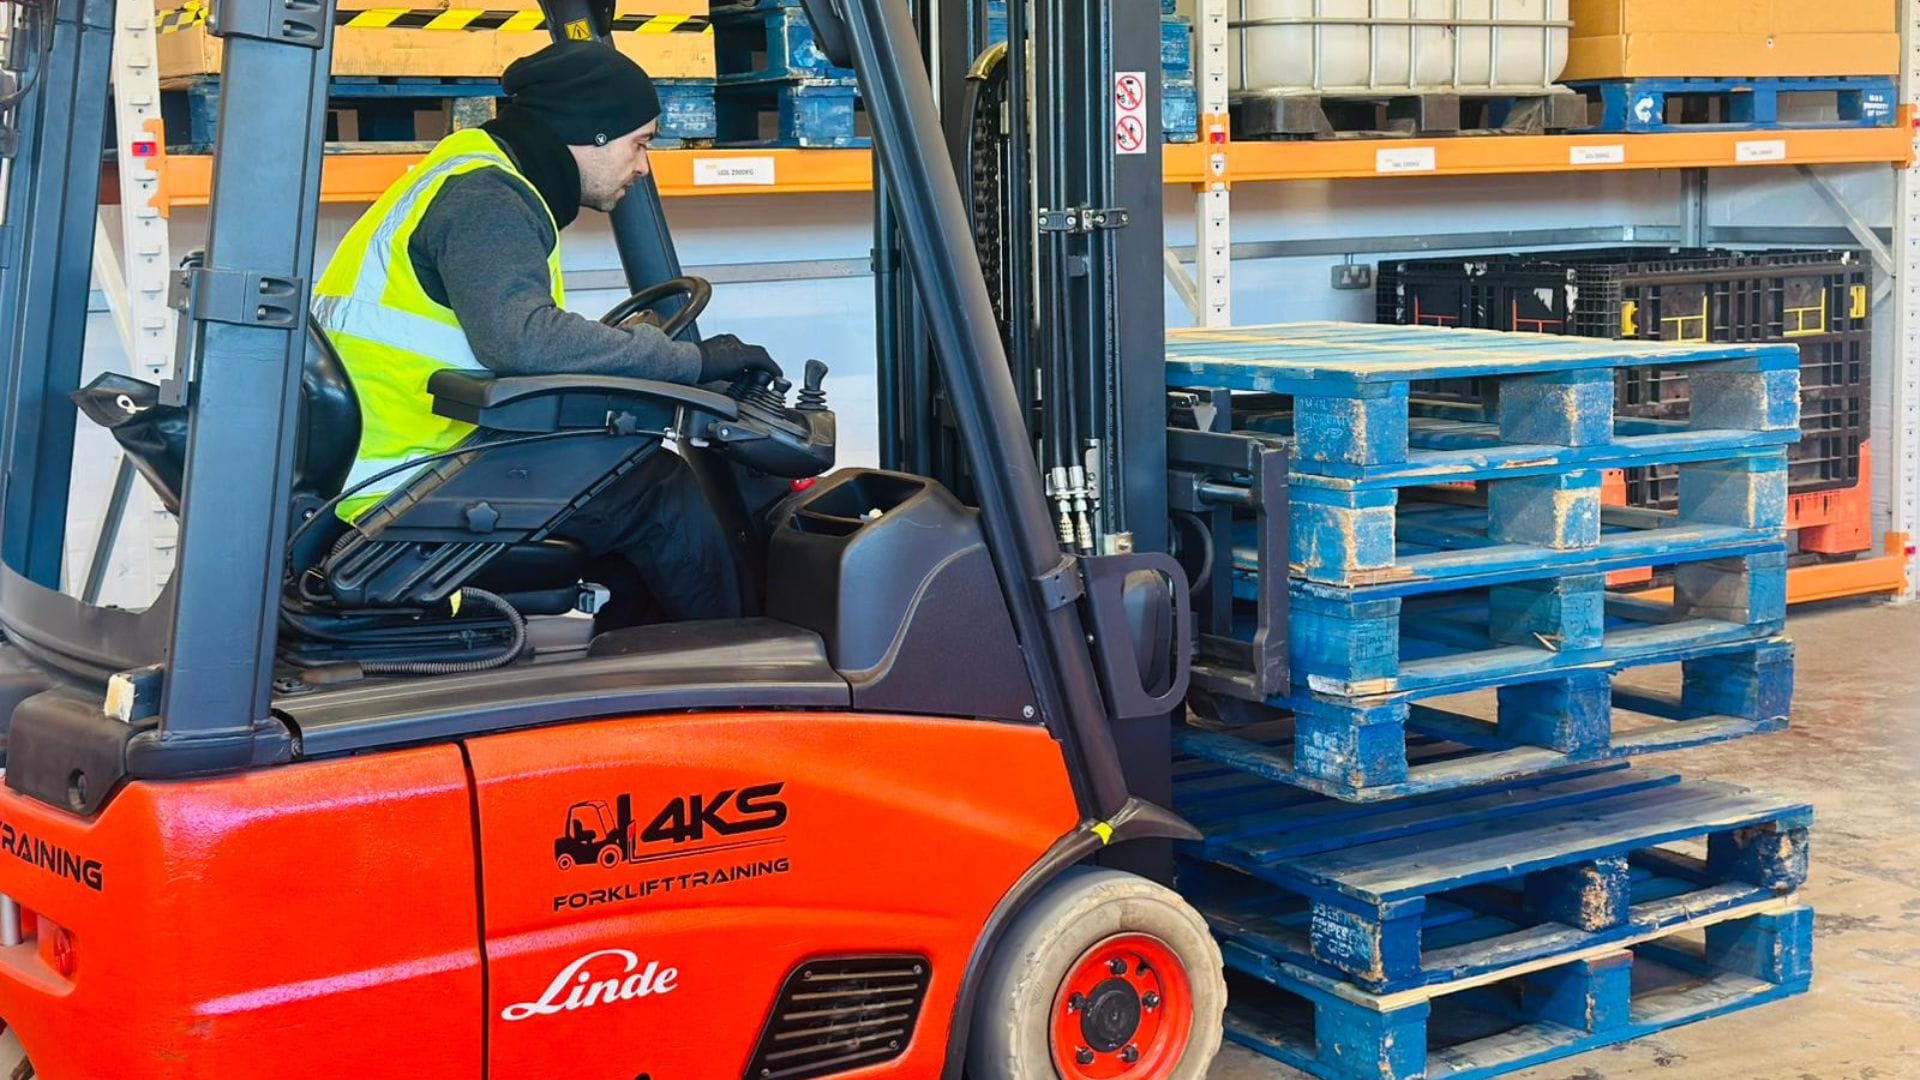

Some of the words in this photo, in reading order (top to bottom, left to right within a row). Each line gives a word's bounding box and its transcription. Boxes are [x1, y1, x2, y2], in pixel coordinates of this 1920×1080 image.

[640, 781, 788, 843] 4KS
[0, 821, 103, 892] RAINING
[500, 948, 679, 1021] Linde
